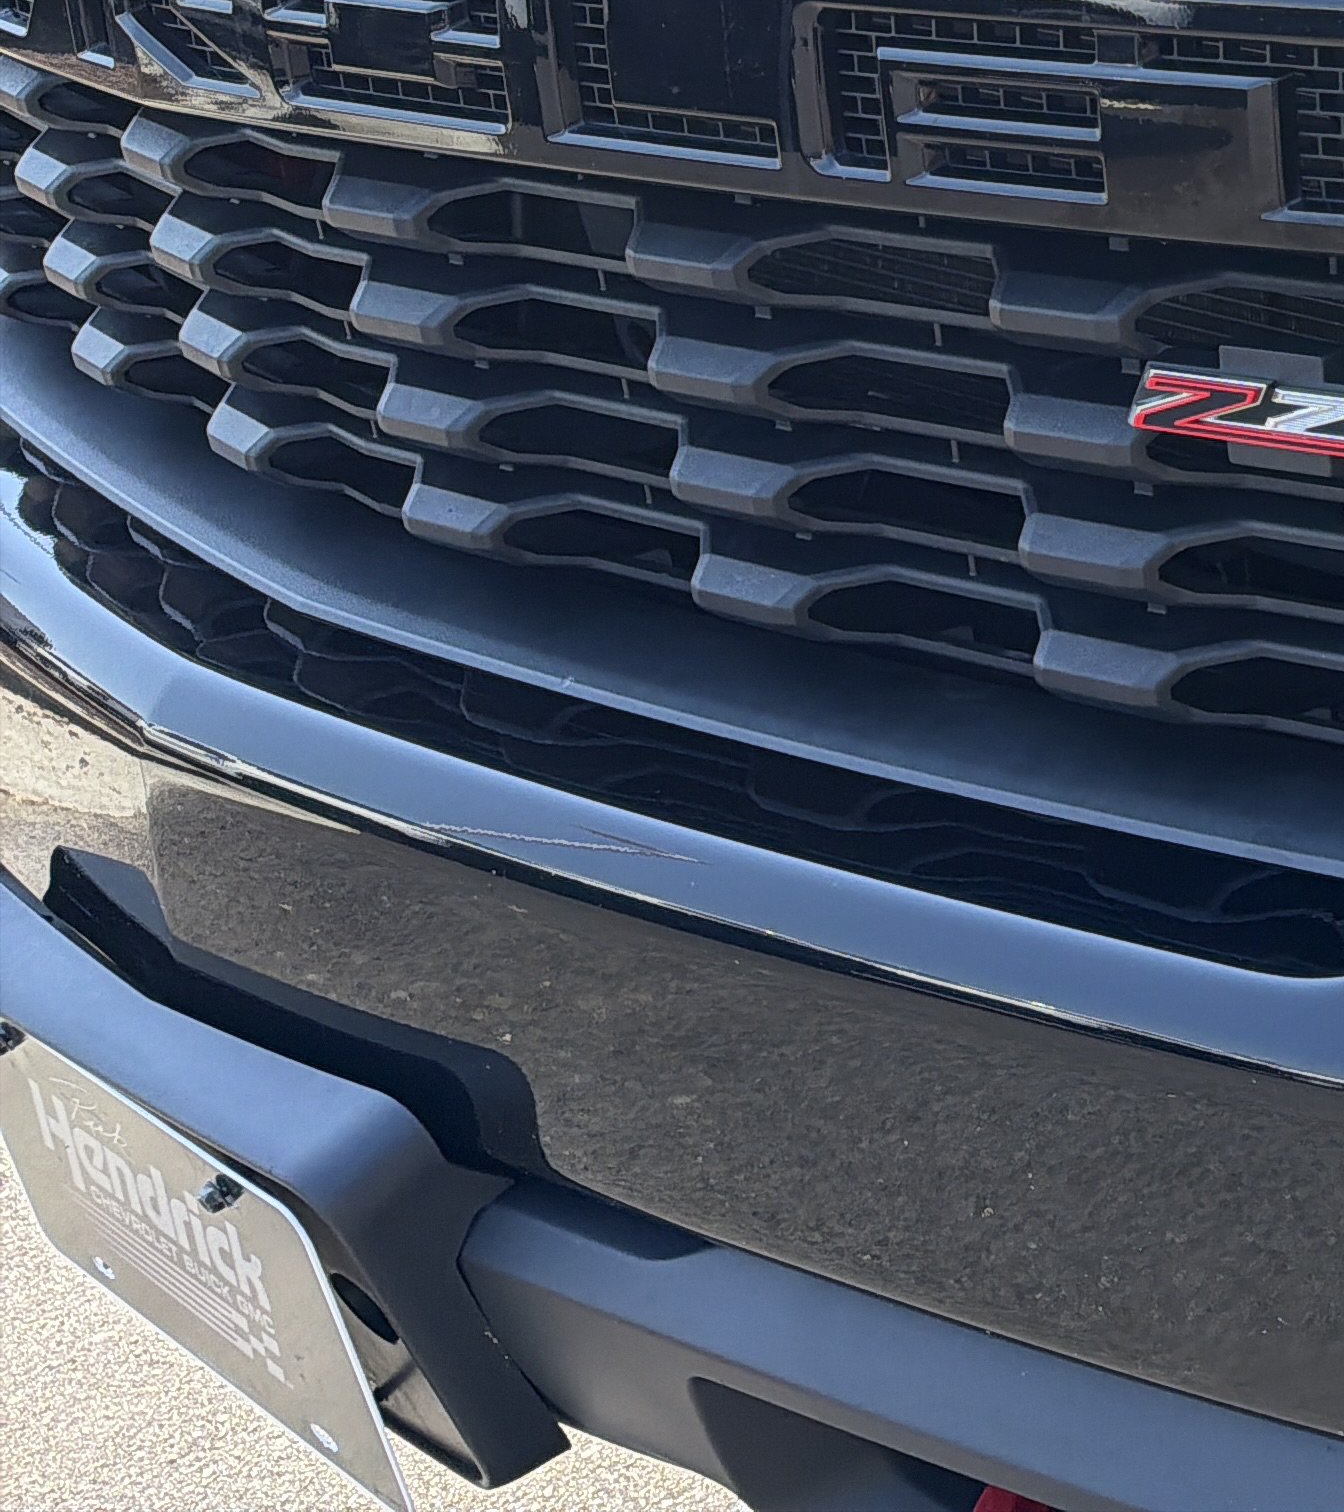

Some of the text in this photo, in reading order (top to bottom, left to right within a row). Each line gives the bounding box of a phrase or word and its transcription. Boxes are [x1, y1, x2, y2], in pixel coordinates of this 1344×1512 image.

[27, 1077, 272, 1314] Hendrick
[89, 1185, 276, 1335] CHEVROLET BUICK GMC
